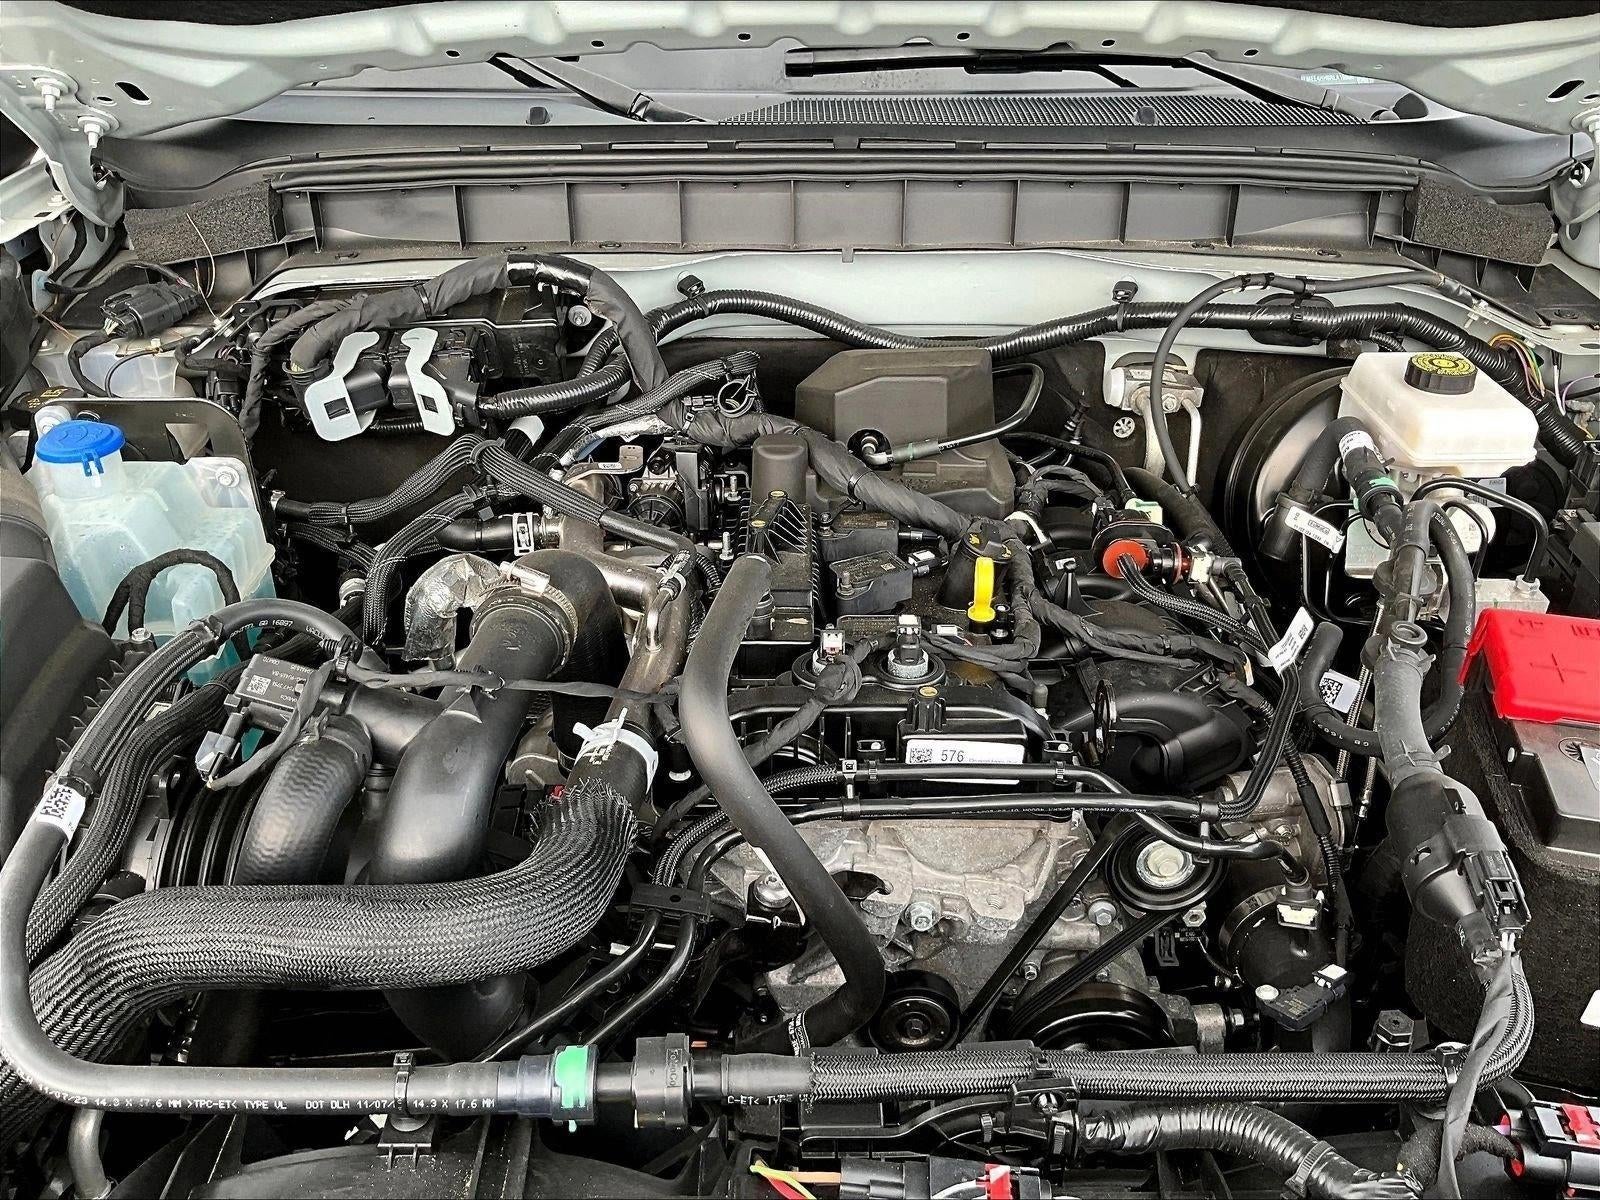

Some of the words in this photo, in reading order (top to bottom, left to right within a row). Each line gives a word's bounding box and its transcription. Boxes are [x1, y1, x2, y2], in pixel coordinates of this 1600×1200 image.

[941, 749, 965, 762] 576
[168, 1099, 182, 1108] MM
[244, 1100, 269, 1109] TYPE
[305, 1100, 324, 1109] DOT
[356, 1100, 397, 1109] 11/07/
[413, 1099, 437, 1108] 14.3
[442, 1099, 449, 1108] X
[455, 1099, 478, 1108] 17.6
[482, 1098, 495, 1107] MM
